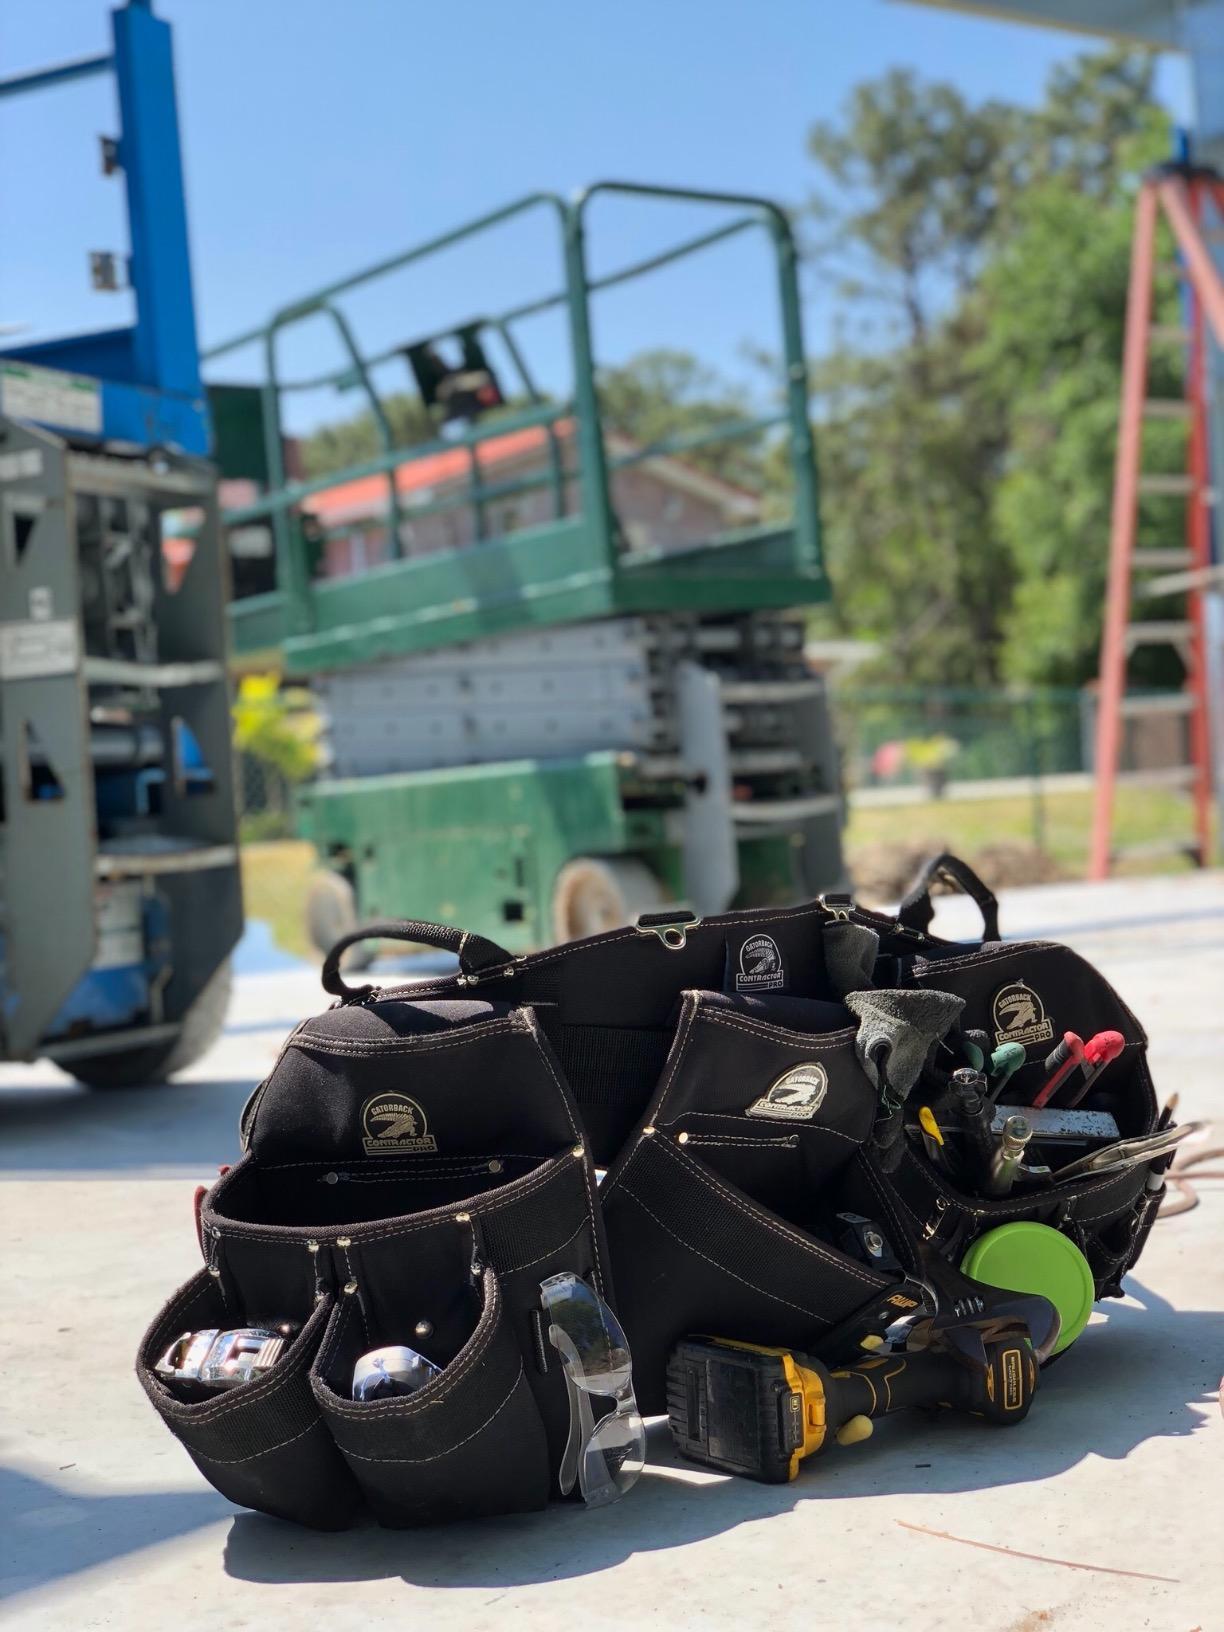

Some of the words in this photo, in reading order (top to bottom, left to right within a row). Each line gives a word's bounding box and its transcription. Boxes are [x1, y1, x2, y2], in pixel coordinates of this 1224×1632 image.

[739, 973, 781, 982] CONTRACTOR
[768, 980, 783, 988] PRO
[998, 994, 1031, 1008] GATORBACK
[999, 1023, 1048, 1040] CONTRACTOR
[1034, 1031, 1051, 1041] PRO
[371, 1104, 413, 1115] GATORBACK
[367, 1138, 431, 1146] CONTRACTOR
